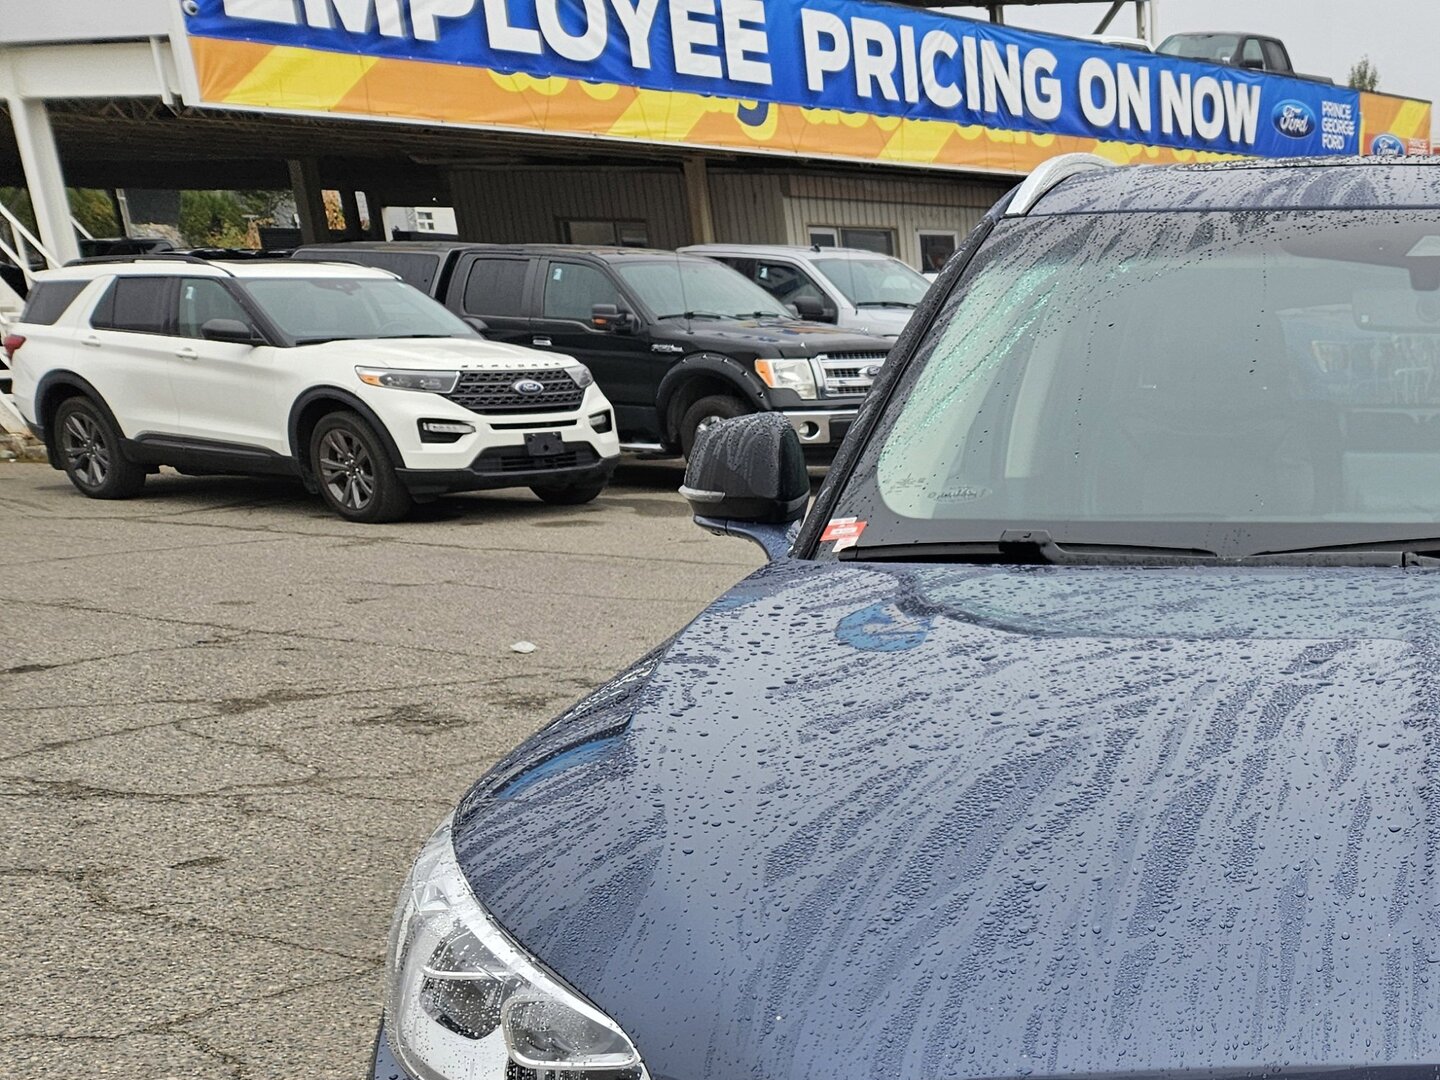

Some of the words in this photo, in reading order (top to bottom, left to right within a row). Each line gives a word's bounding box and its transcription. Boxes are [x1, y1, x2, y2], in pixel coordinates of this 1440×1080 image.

[224, 0, 773, 85] LOYEE
[801, 8, 1062, 120] PRICING
[1079, 57, 1151, 132] ON
[1160, 70, 1261, 144] NOW
[1280, 105, 1309, 133] Ford
[1322, 101, 1352, 119] PRINCE
[1322, 117, 1355, 136] GEORGE
[1322, 133, 1345, 150] FORD
